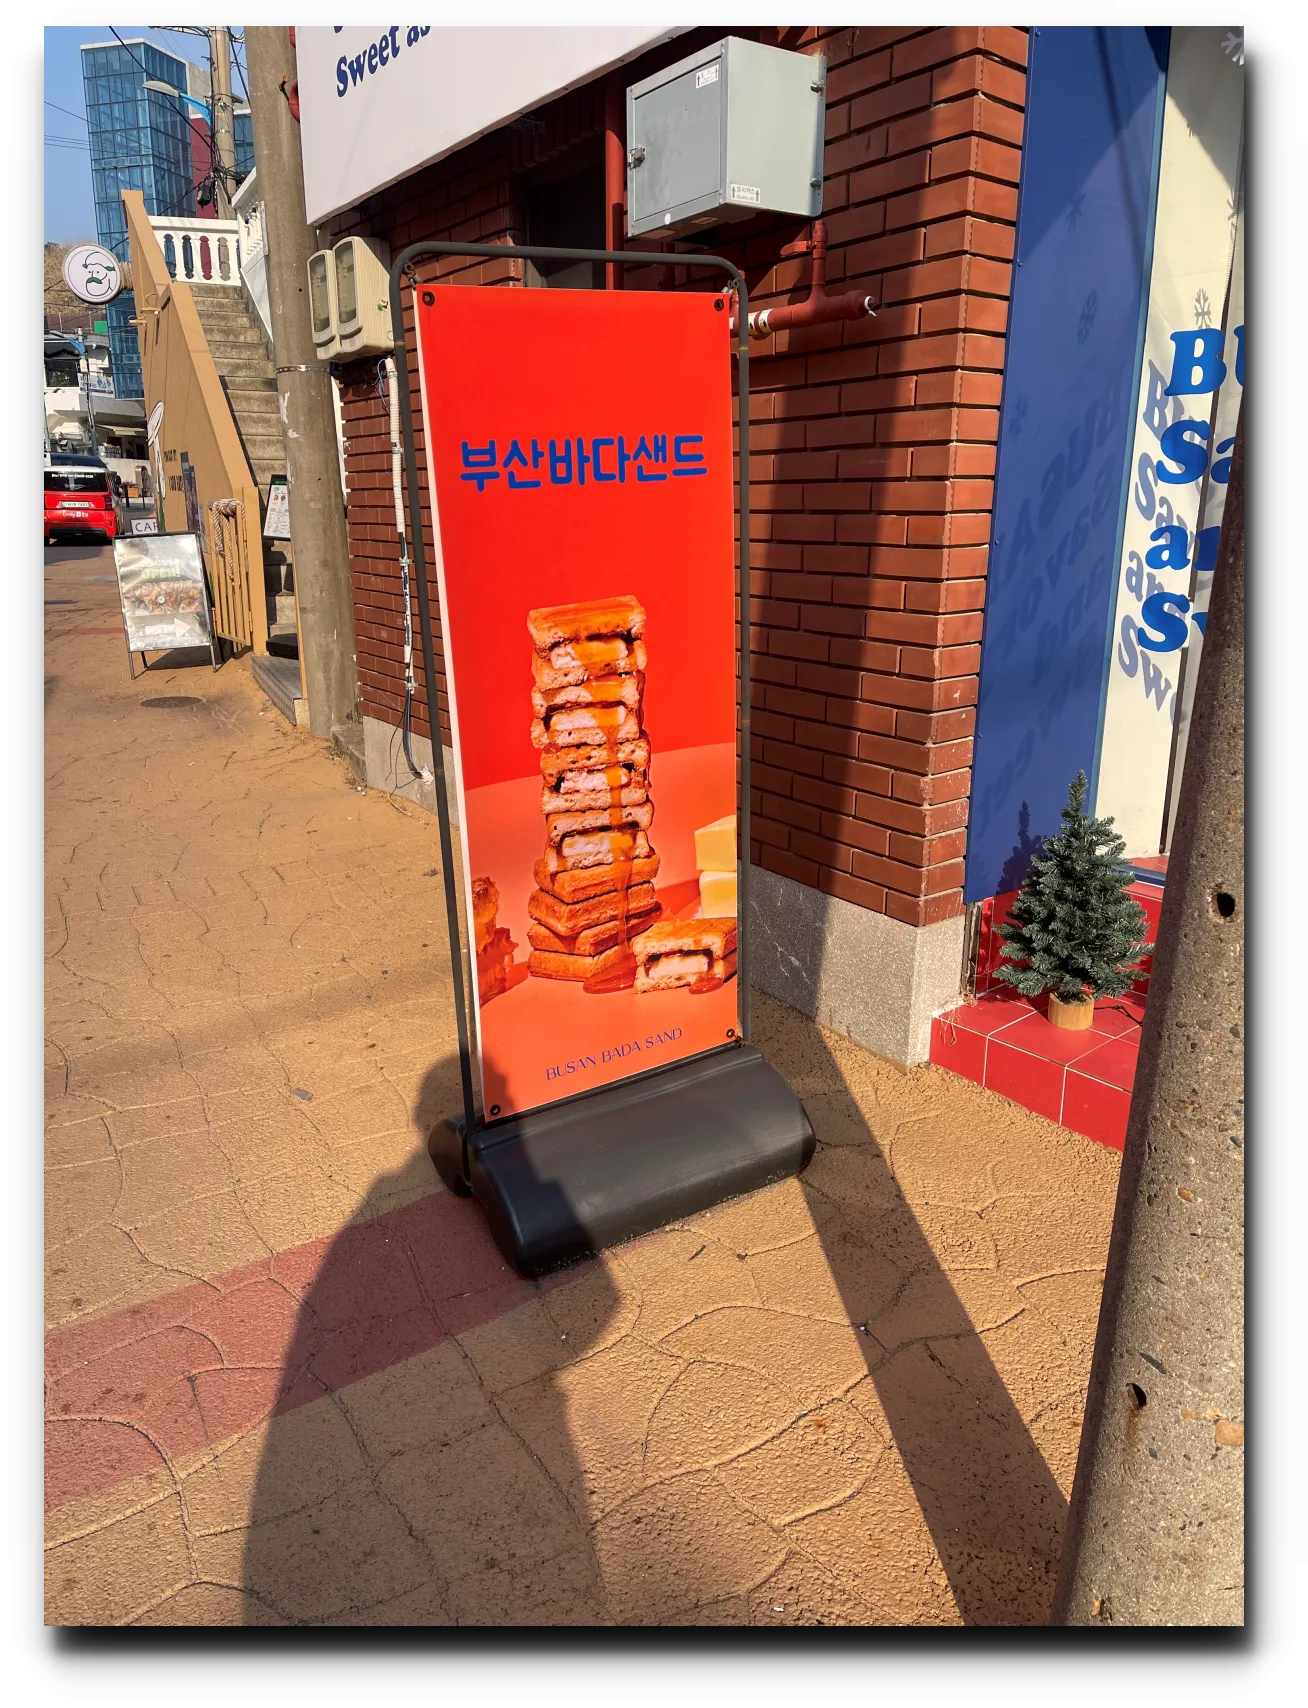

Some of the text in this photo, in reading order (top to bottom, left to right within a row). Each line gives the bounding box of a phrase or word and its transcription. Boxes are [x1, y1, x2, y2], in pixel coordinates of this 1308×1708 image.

[336, 26, 400, 98] Sweet
[459, 433, 708, 493] 부산바다샌드
[546, 1027, 683, 1080] BUSAN BADA SAND
